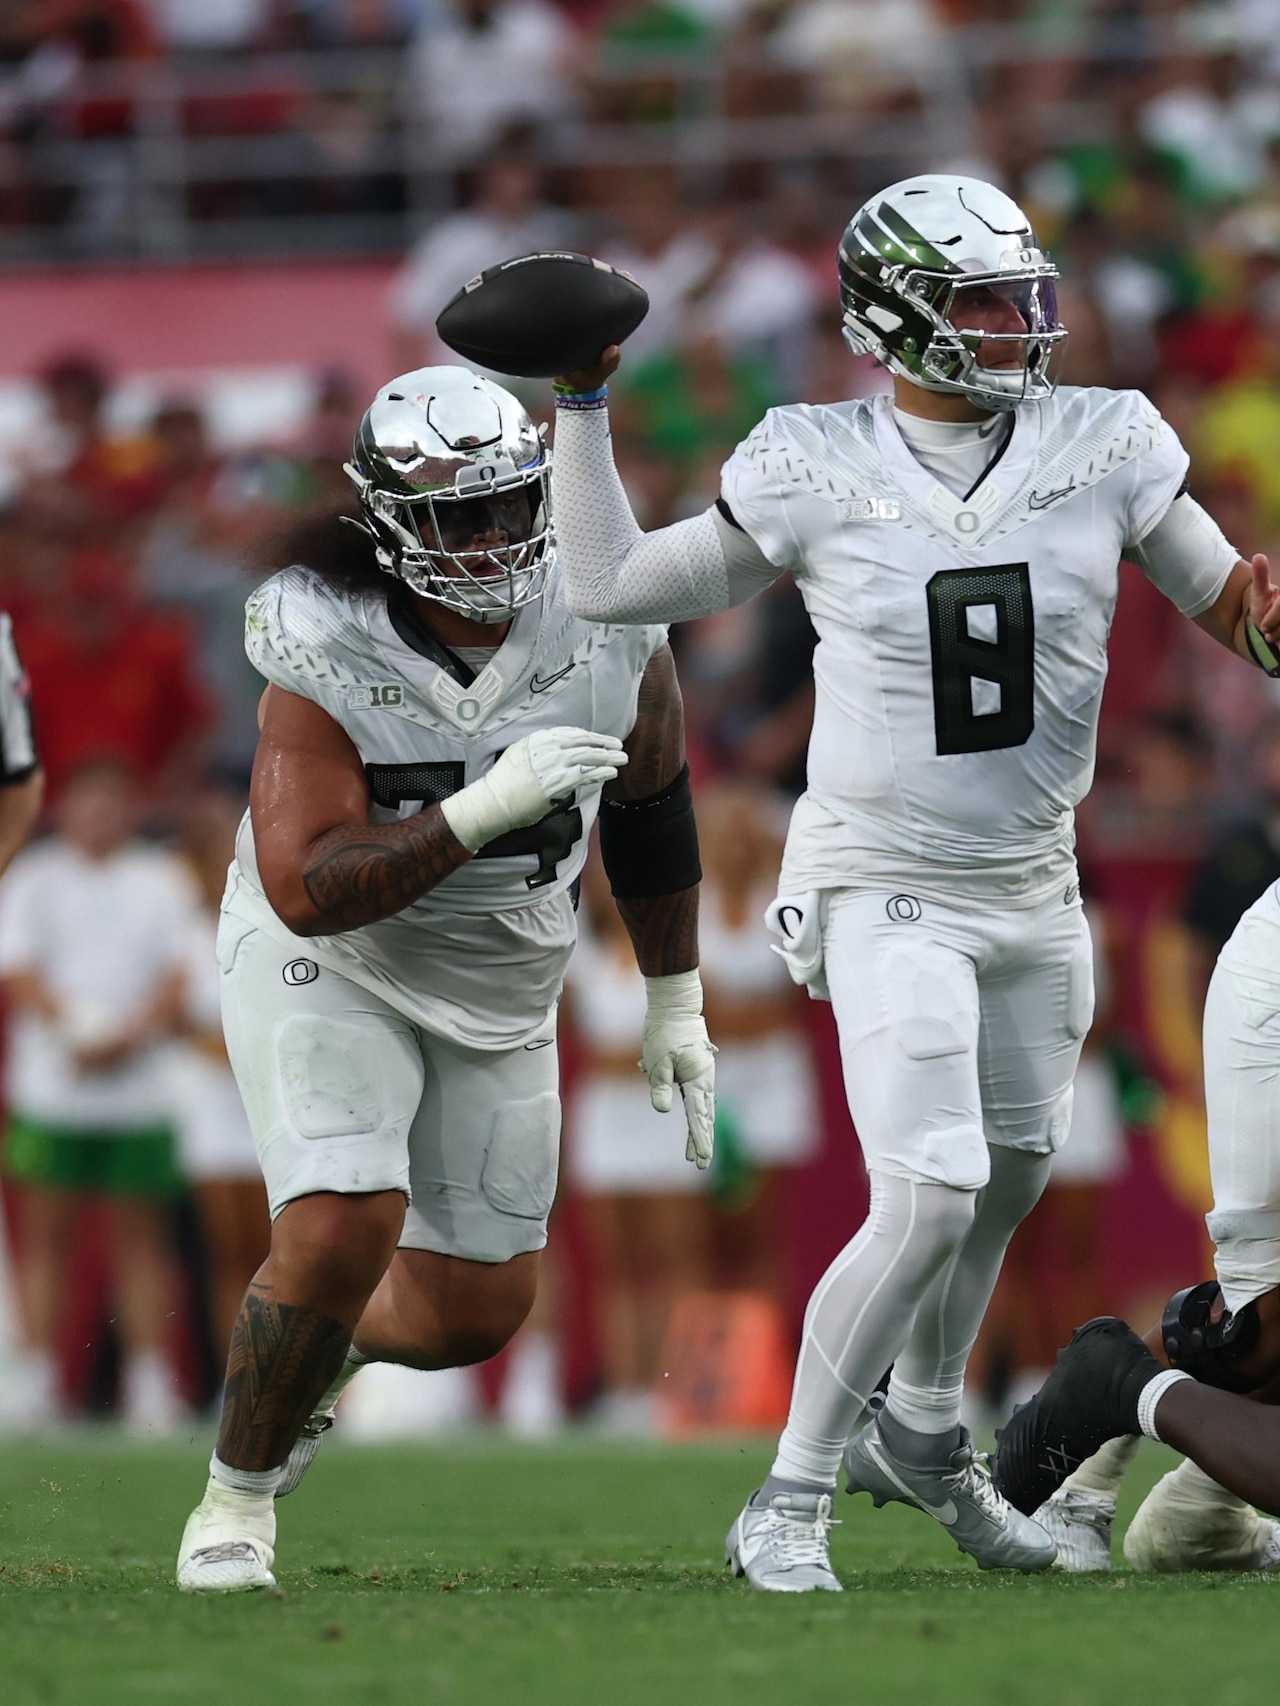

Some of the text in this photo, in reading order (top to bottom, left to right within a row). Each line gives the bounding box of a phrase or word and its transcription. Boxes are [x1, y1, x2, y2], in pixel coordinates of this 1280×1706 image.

[954, 511, 979, 533] O
[925, 562, 1035, 756] 8
[456, 698, 480, 720] O
